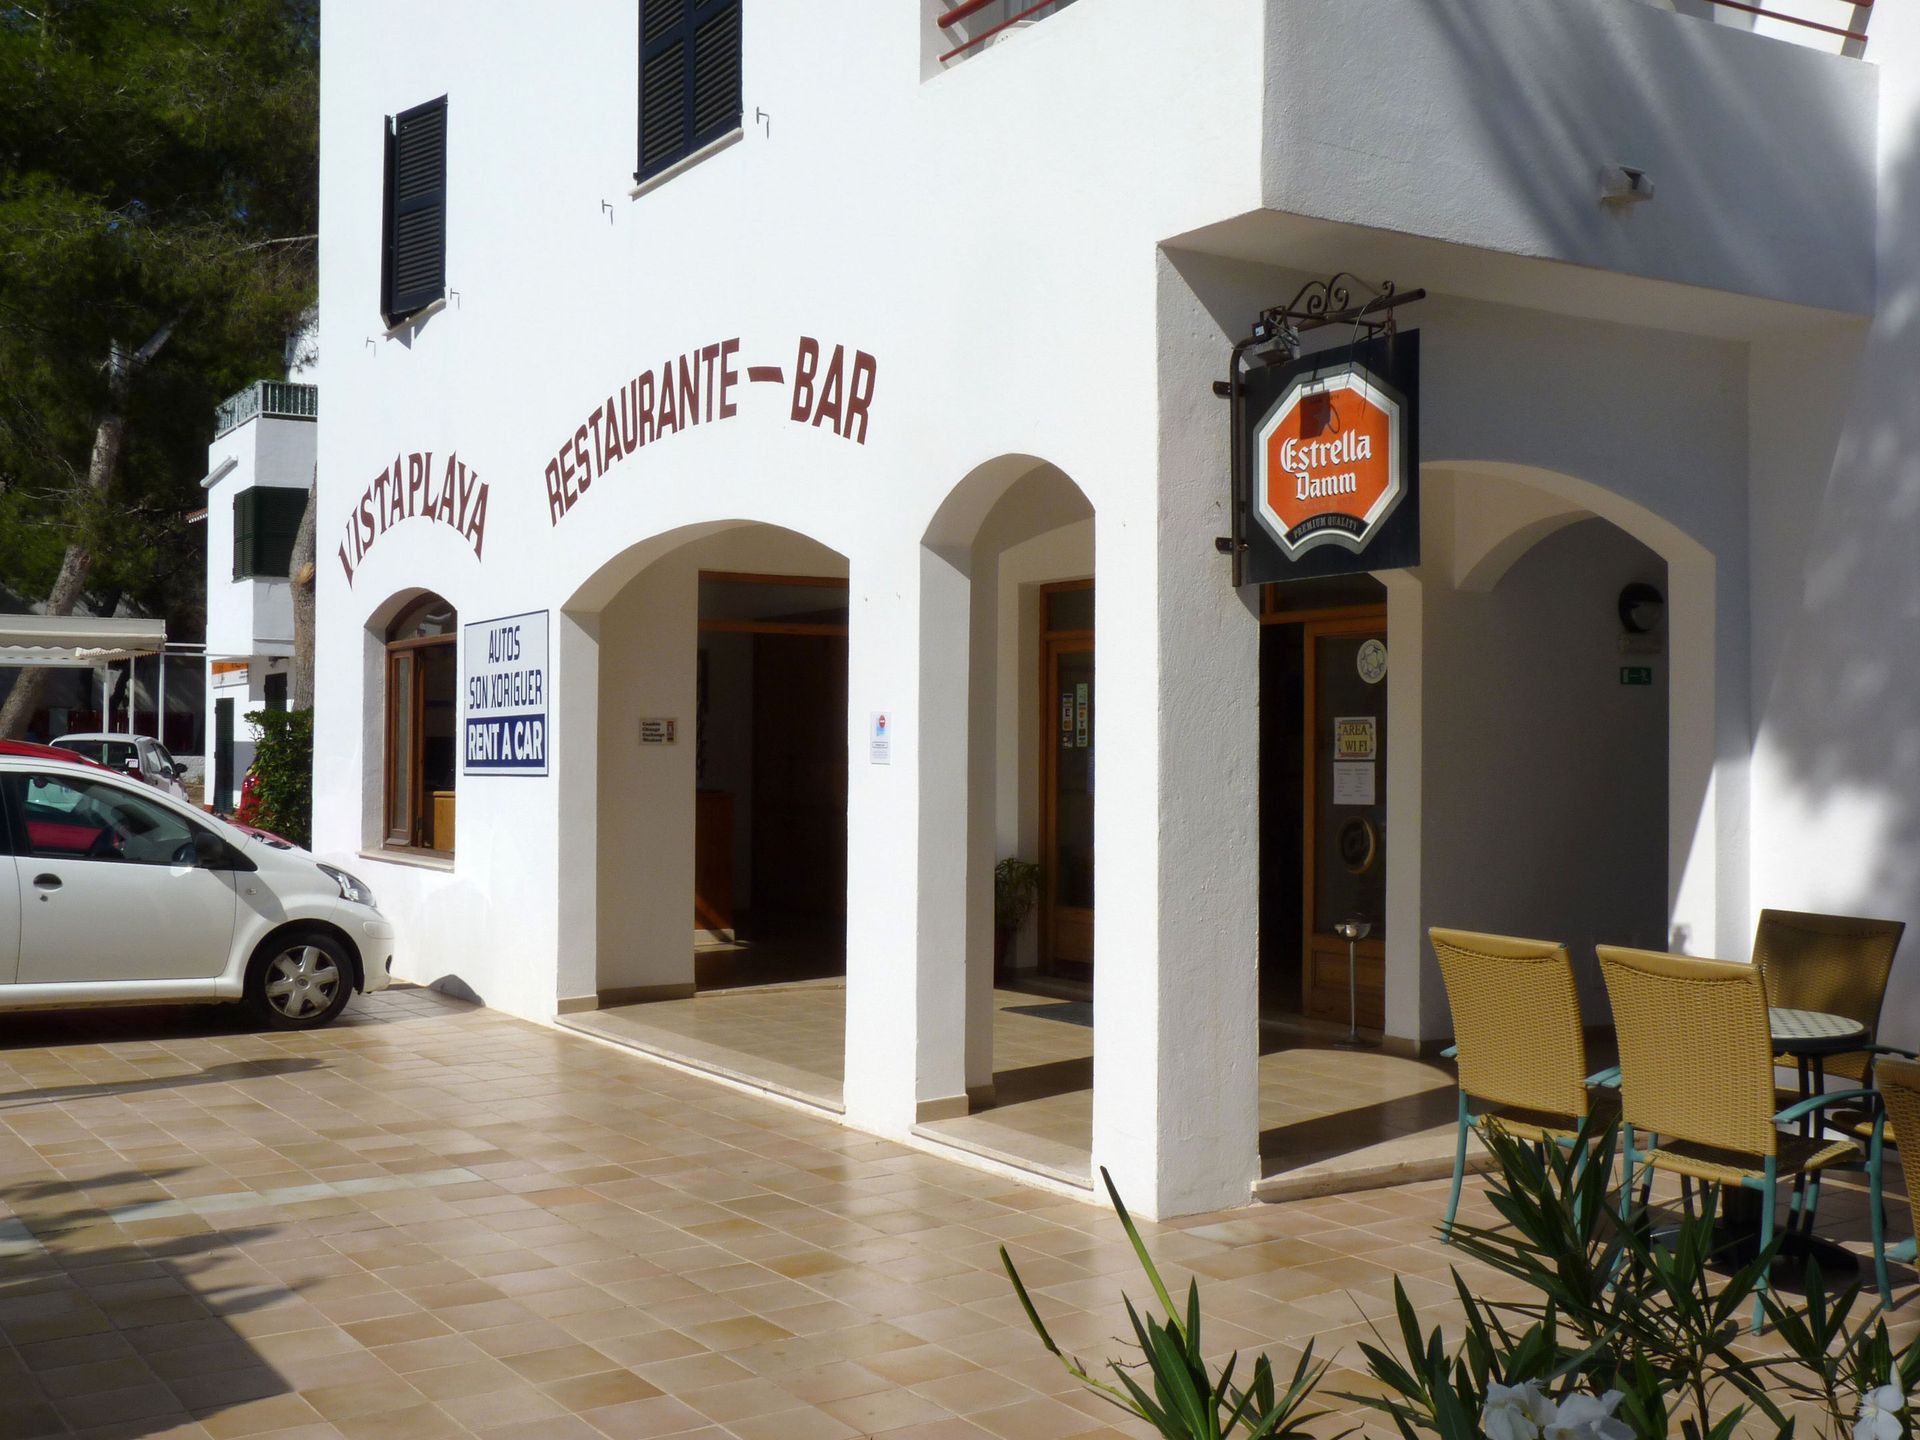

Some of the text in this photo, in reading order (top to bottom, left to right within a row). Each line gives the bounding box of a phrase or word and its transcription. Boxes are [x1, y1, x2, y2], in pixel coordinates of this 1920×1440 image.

[544, 337, 740, 528] RESTAURANTE
[790, 335, 877, 445] BAR
[1280, 428, 1372, 473] Estrella
[1295, 471, 1357, 501] Damm
[1293, 515, 1358, 539] PREMIUM QUALITY
[488, 625, 521, 664] AUTOS
[469, 669, 542, 710] SON XORIGUER
[468, 720, 543, 761] RENT A CAR
[1343, 724, 1368, 736] AREA
